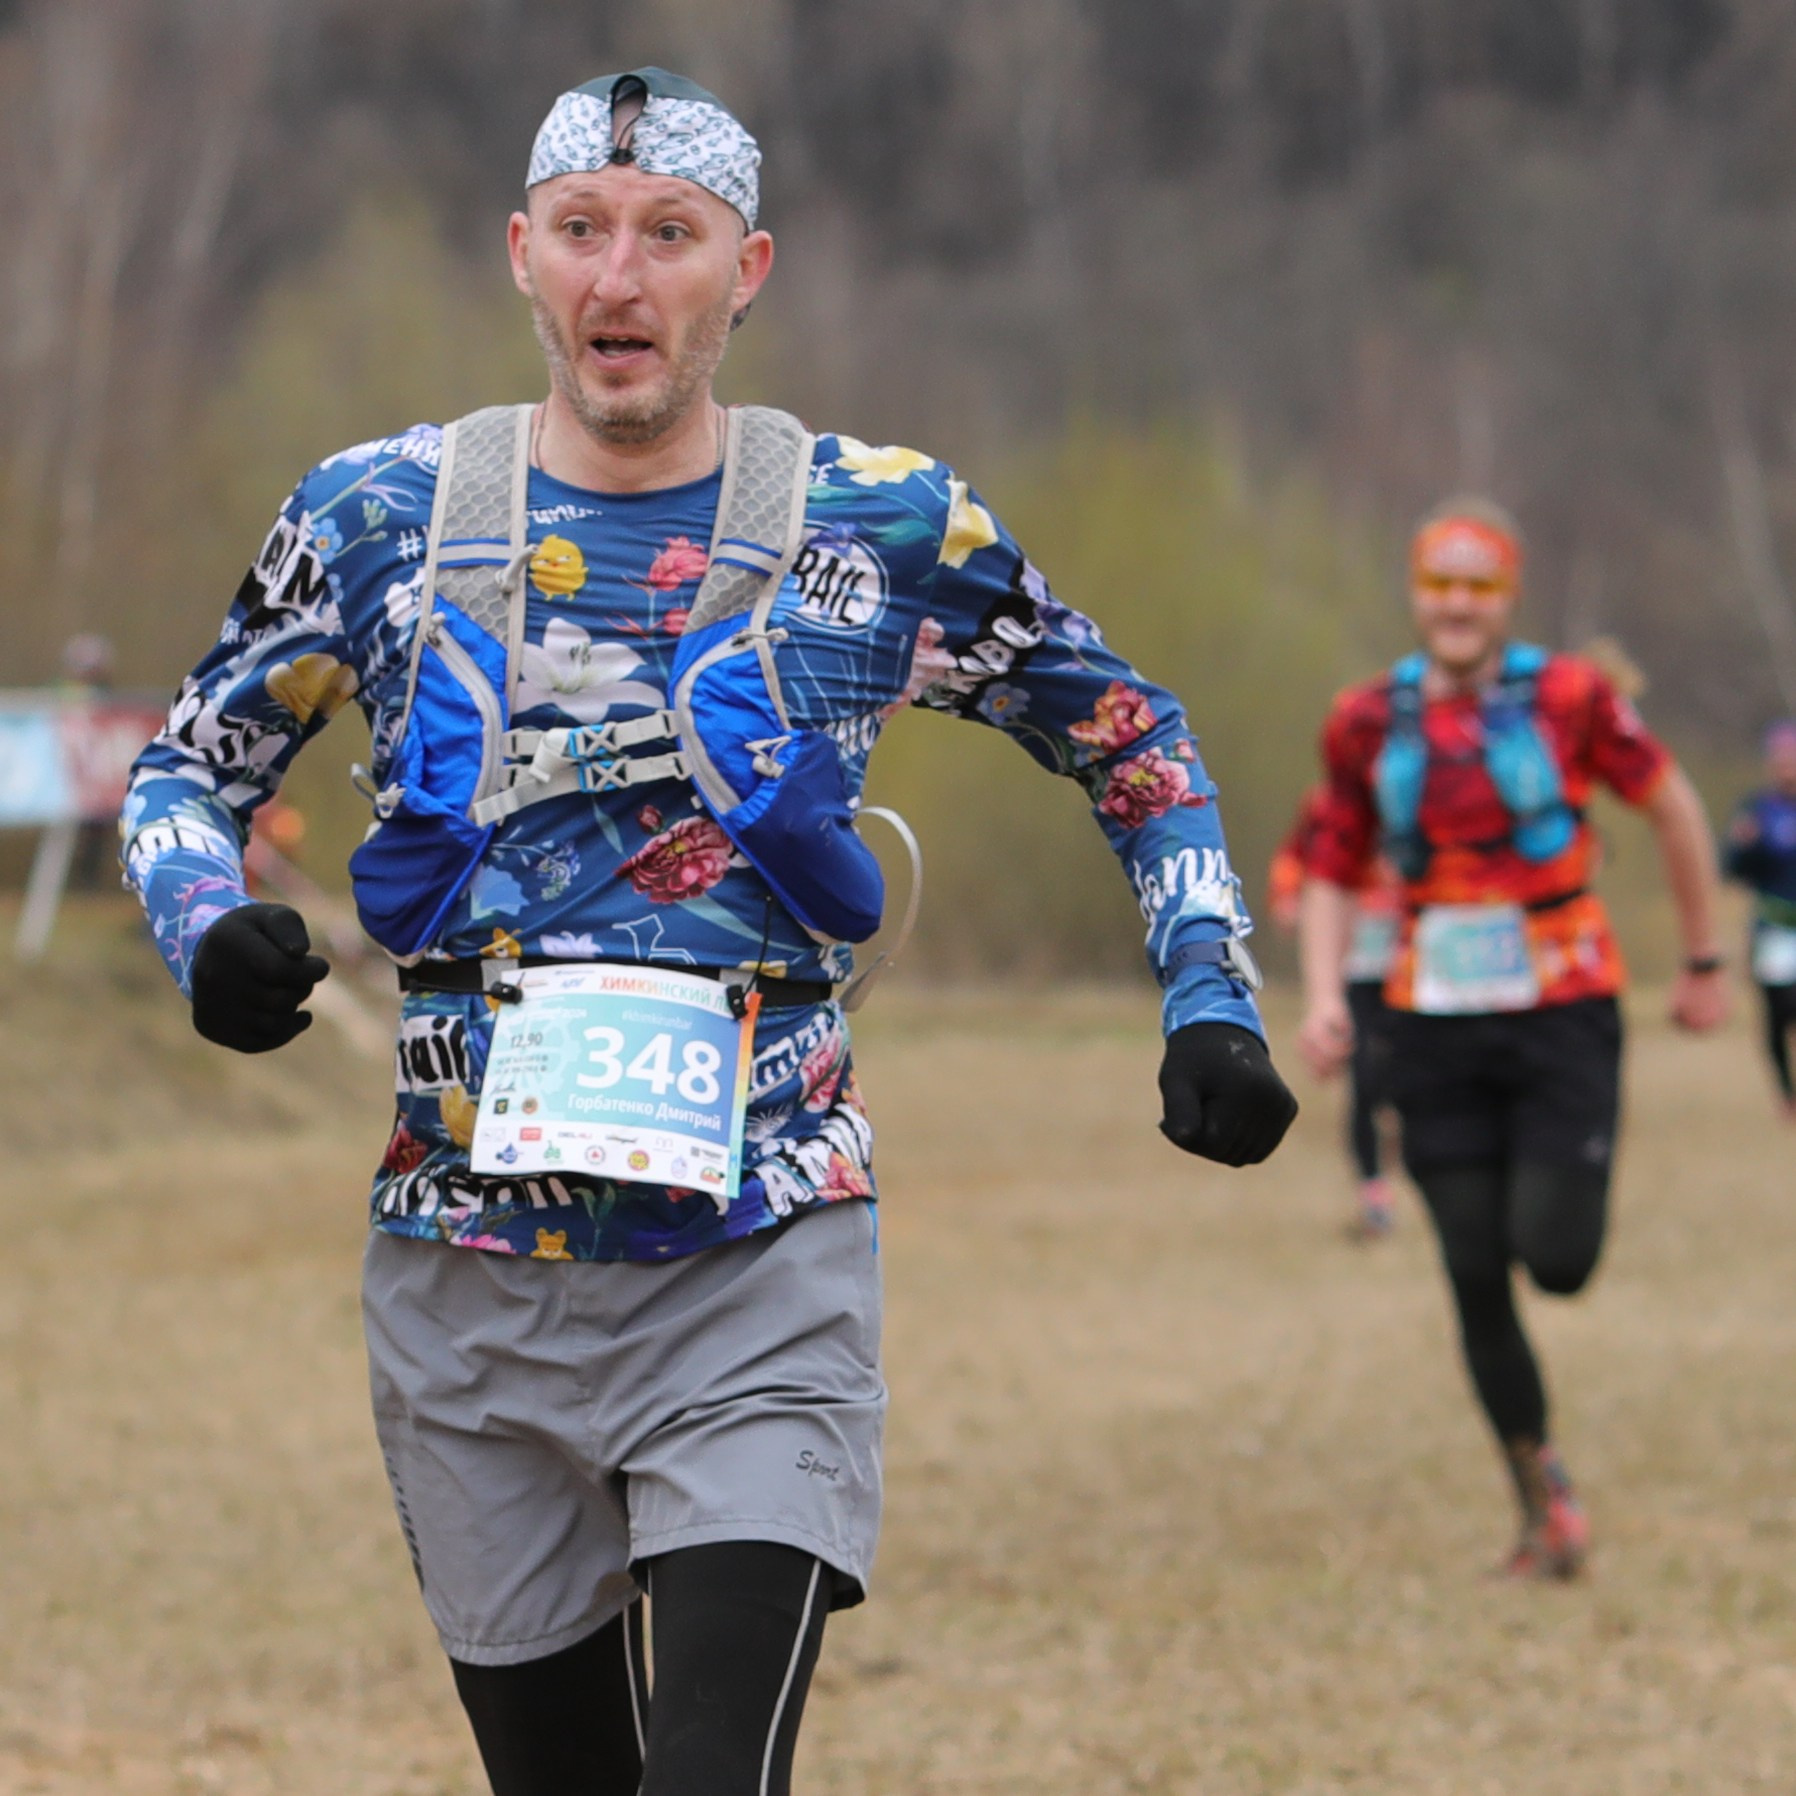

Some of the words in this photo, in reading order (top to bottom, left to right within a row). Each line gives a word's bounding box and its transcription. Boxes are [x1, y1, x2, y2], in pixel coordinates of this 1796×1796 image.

[793, 542, 866, 625] RAIL
[600, 975, 710, 1004] ХИМКИНСКИЙ
[576, 1025, 722, 1105] 348
[567, 1093, 654, 1117] Горбатенко
[655, 1102, 722, 1132] Дмитрий
[796, 1449, 840, 1482] Sport
